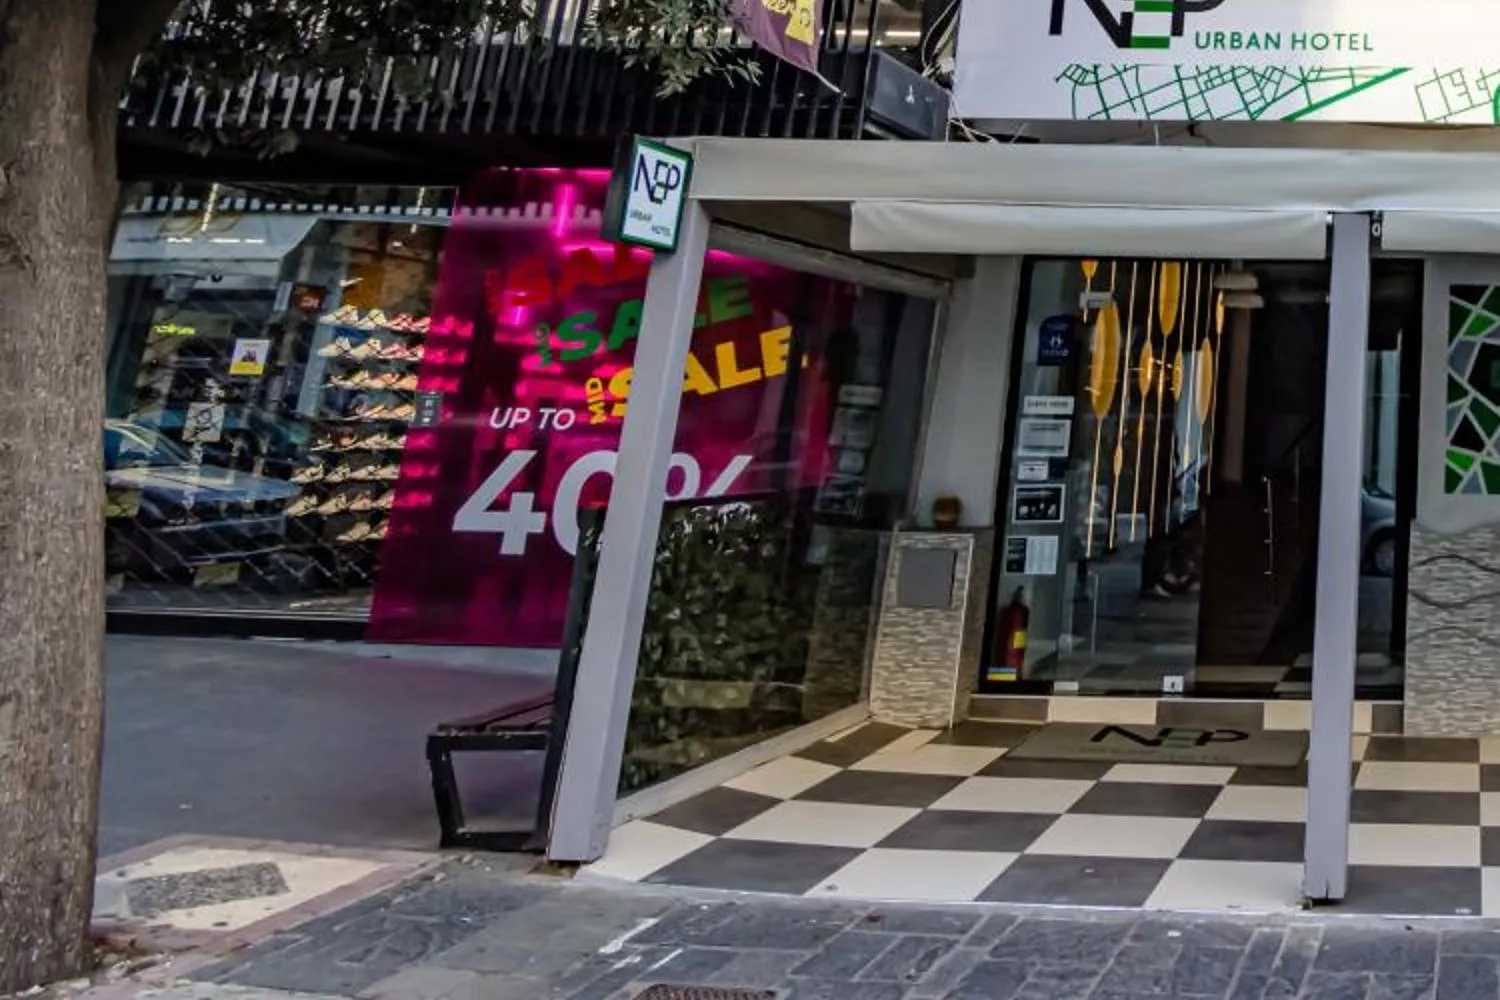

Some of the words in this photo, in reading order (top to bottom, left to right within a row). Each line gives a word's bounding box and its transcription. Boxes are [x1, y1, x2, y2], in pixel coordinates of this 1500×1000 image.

[1194, 31, 1283, 52] URBAN
[1291, 32, 1374, 52] HOTEL
[633, 153, 681, 205] NEP
[505, 245, 652, 308] SAL
[557, 276, 754, 362] SAE
[489, 406, 530, 430] UP
[539, 407, 577, 431] TO
[1089, 724, 1250, 748] NEP
